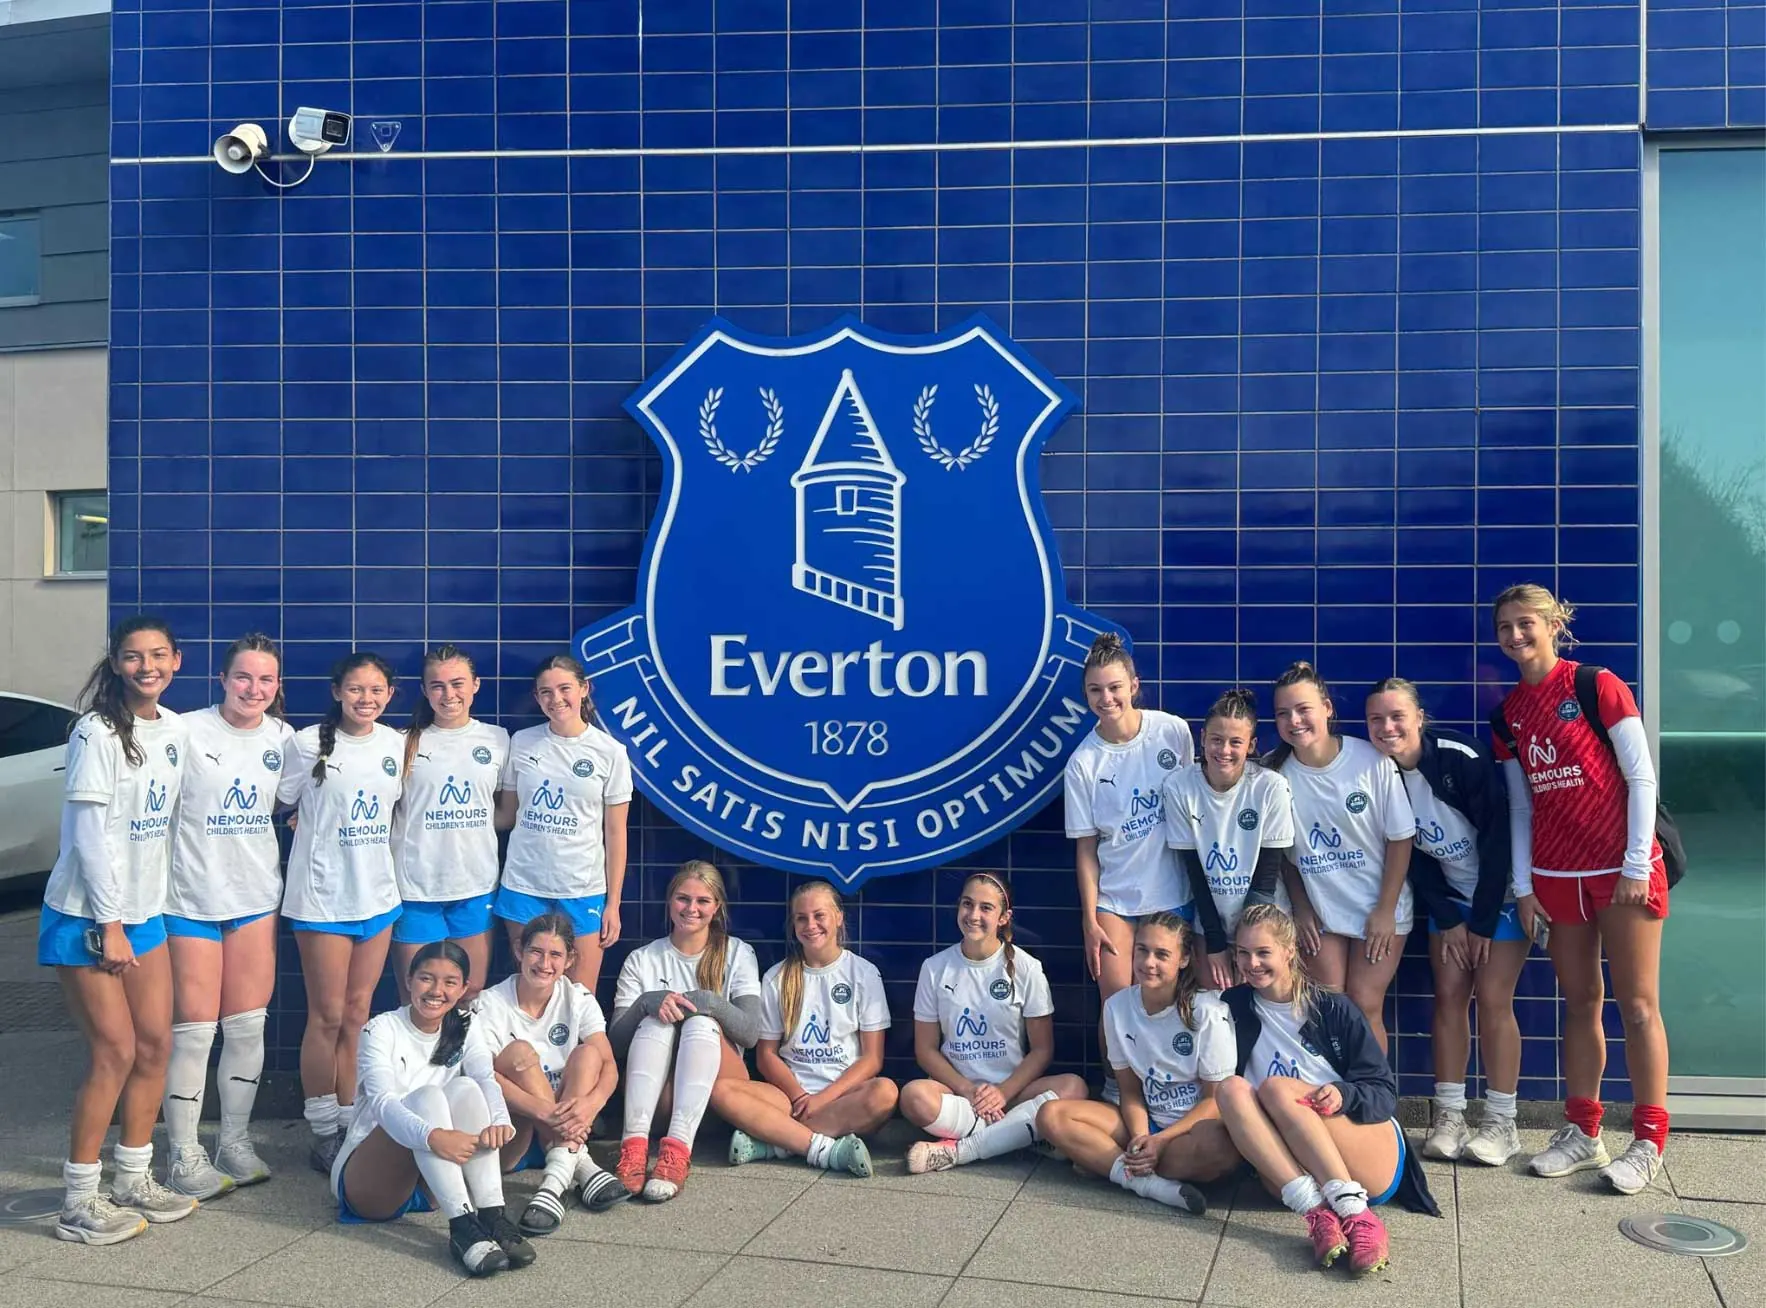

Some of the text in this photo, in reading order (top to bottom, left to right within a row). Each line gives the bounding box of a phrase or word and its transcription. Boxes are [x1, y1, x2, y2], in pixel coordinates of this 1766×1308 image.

[710, 633, 988, 697] Everton
[804, 719, 889, 756] 1878
[612, 696, 1087, 851] NIL SATIS NISI OPTIMUM
[206, 814, 271, 826] NEMOURS
[425, 808, 488, 821] NEMOURS
[425, 819, 487, 830] CHILDREN'S HEALTH
[551, 825, 577, 837] HEALTH
[1299, 848, 1364, 866] NEMOURS
[1339, 859, 1366, 869] HEALTH
[948, 1039, 1006, 1053] NEMOURS
[982, 1049, 1007, 1059] HEALTH
